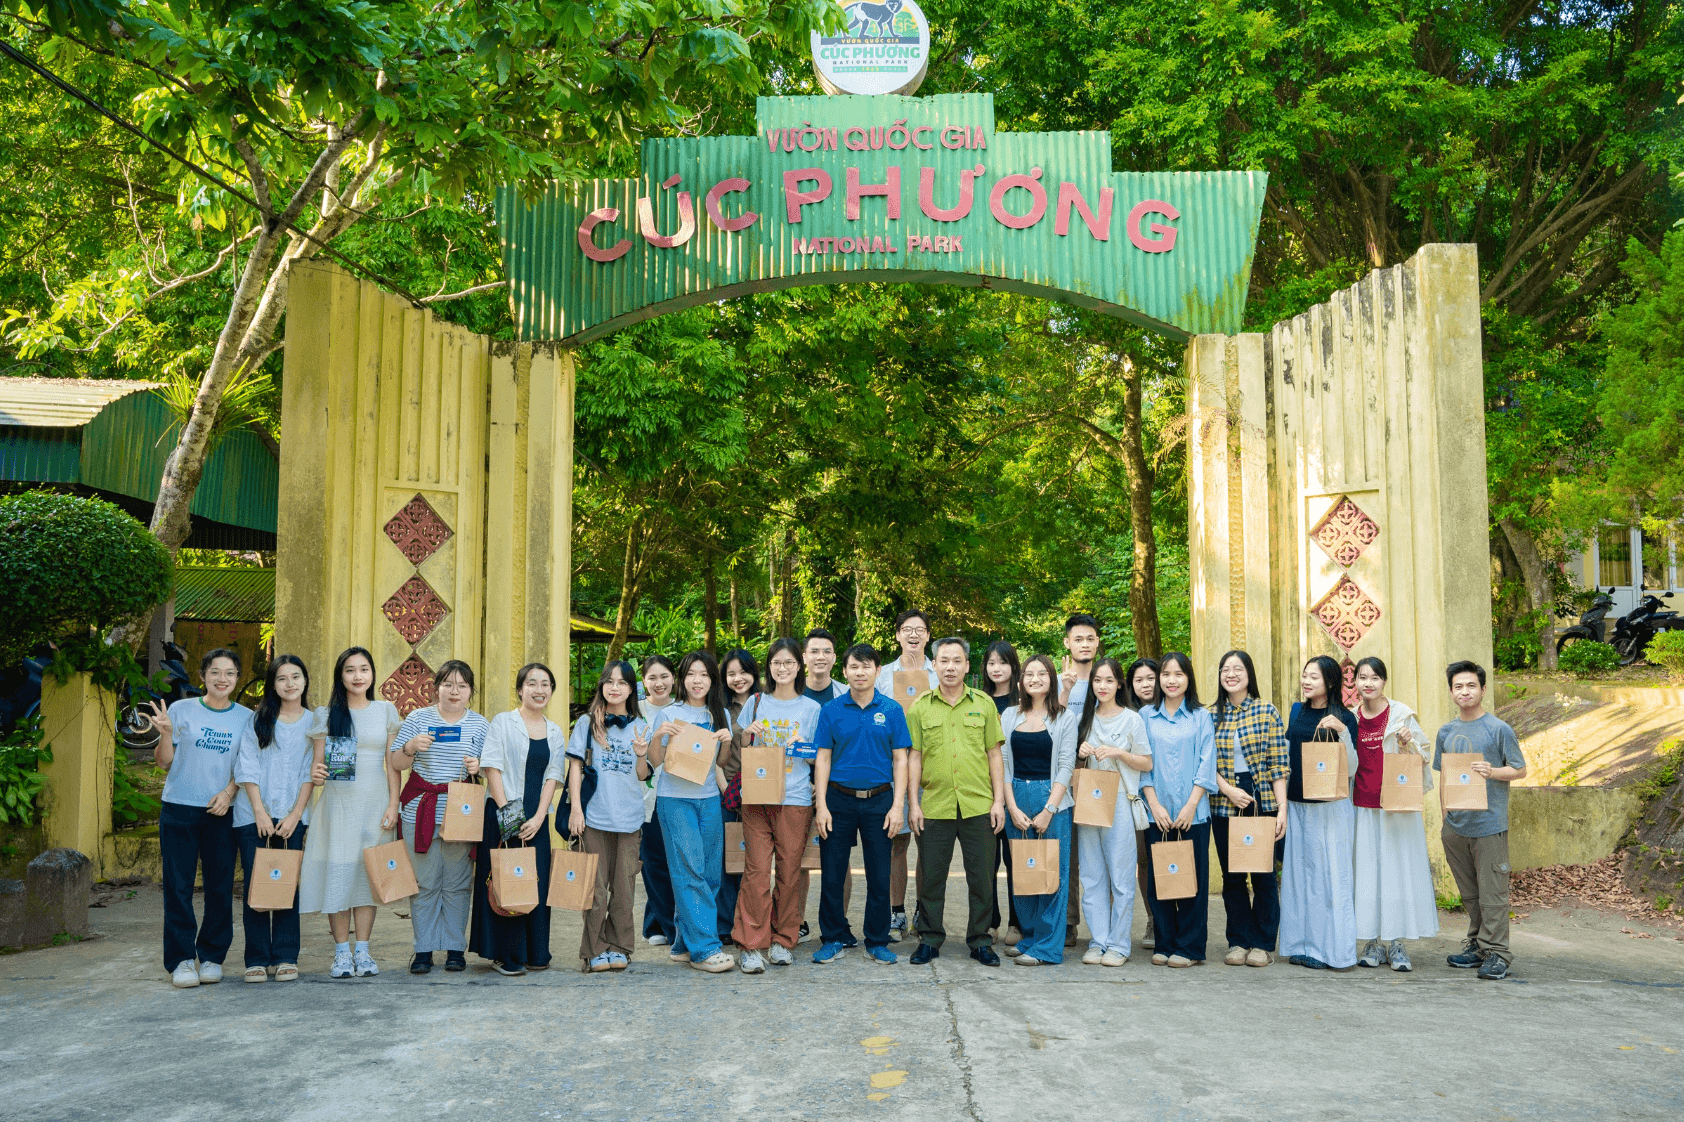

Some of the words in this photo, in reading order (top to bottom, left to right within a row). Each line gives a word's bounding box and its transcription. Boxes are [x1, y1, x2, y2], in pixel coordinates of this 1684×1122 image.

[820, 43, 850, 59] CÚC
[852, 44, 920, 59] PHƯƠNG
[766, 120, 838, 152] VƯỜN
[843, 118, 934, 151] QUỐC
[940, 125, 987, 150] GIA
[578, 172, 759, 262] CÚC
[783, 163, 1181, 254] PHƯƠNG
[792, 235, 898, 255] NATIONAL
[907, 235, 964, 253] PARK
